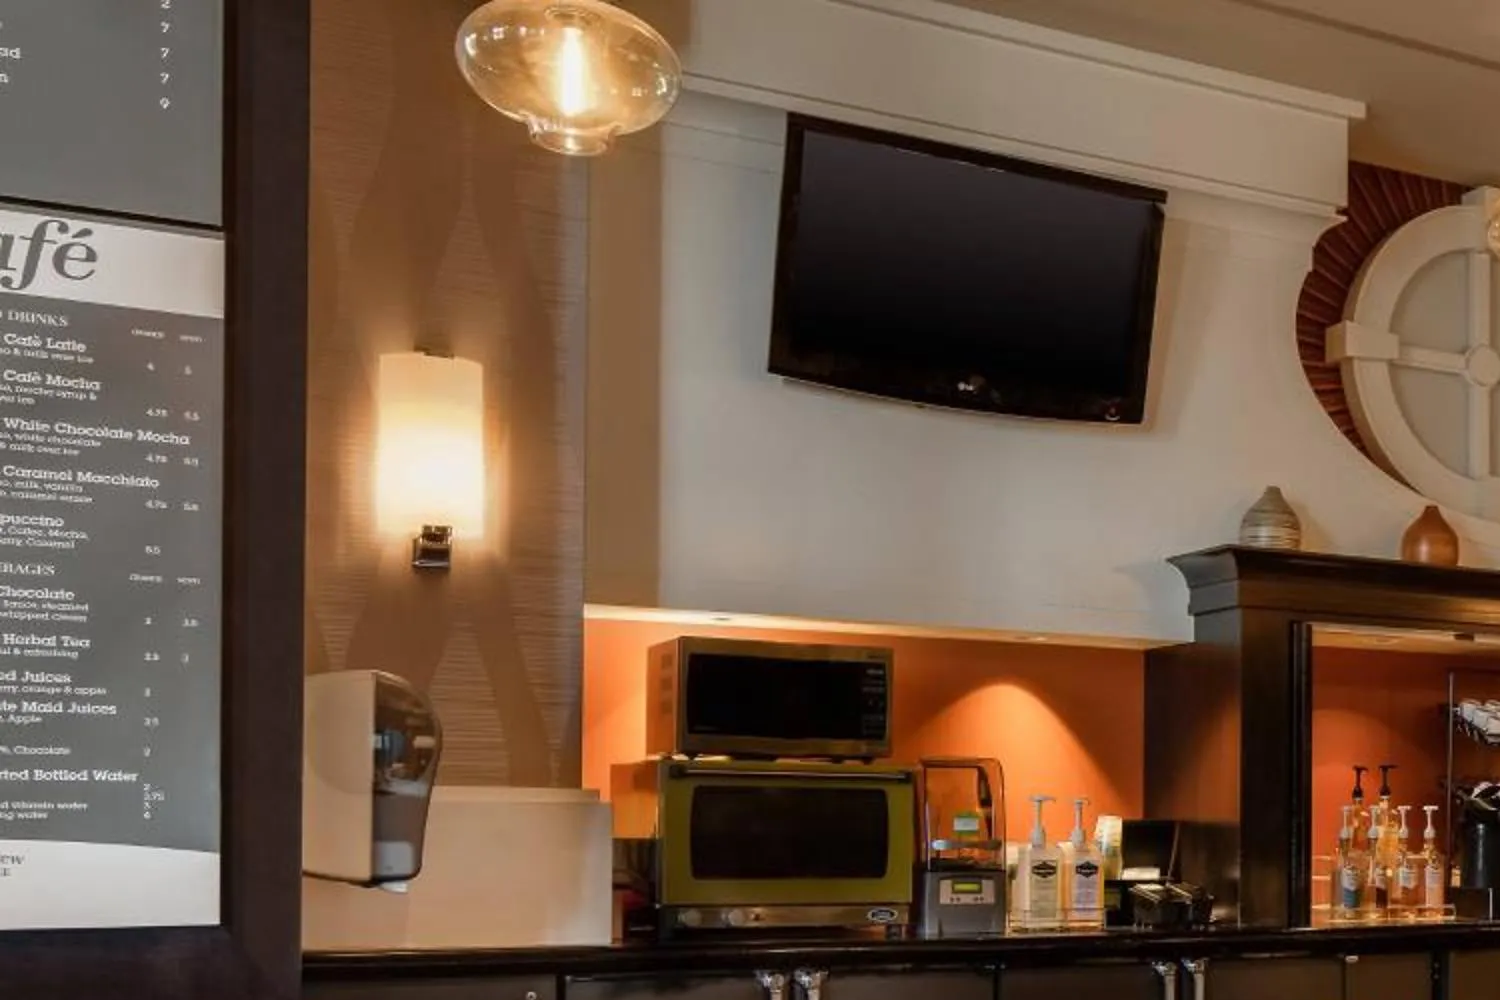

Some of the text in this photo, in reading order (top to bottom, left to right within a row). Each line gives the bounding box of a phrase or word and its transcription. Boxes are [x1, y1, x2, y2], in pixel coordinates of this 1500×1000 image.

[160, 21, 170, 33] 7
[160, 47, 170, 58] 7
[159, 72, 170, 84] 7
[7, 310, 69, 327] DRINKS
[3, 332, 87, 353] Café Latte
[3, 368, 42, 384] Café
[45, 373, 103, 392] Mocha
[3, 417, 190, 446] White Chocolate Mocha
[3, 465, 160, 489] Caramel Macchiato
[2, 633, 92, 649] Herbal Tea
[21, 670, 72, 684] Juices
[21, 700, 64, 714] Maid
[67, 702, 118, 716] Juices
[33, 768, 89, 781] Bottled
[91, 769, 139, 782] Water
